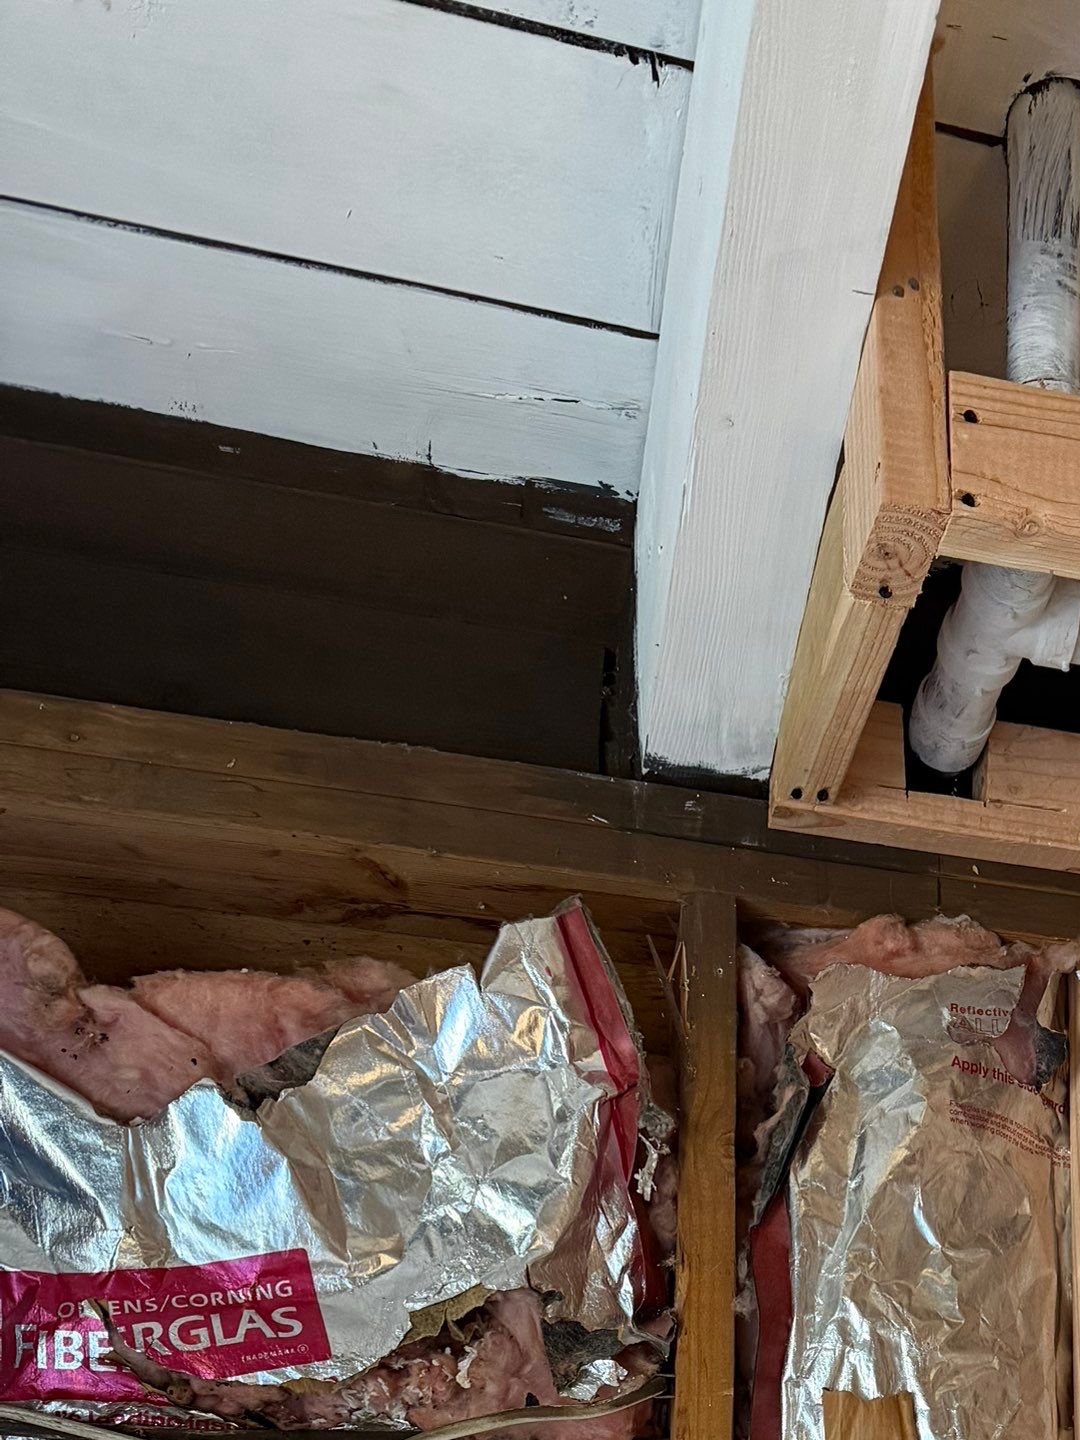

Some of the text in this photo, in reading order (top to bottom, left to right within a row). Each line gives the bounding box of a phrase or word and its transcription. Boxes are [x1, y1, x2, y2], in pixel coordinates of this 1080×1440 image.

[950, 1003, 1011, 1018] Reflectiv
[951, 1055, 989, 1079] Apply
[992, 1067, 1015, 1086] this
